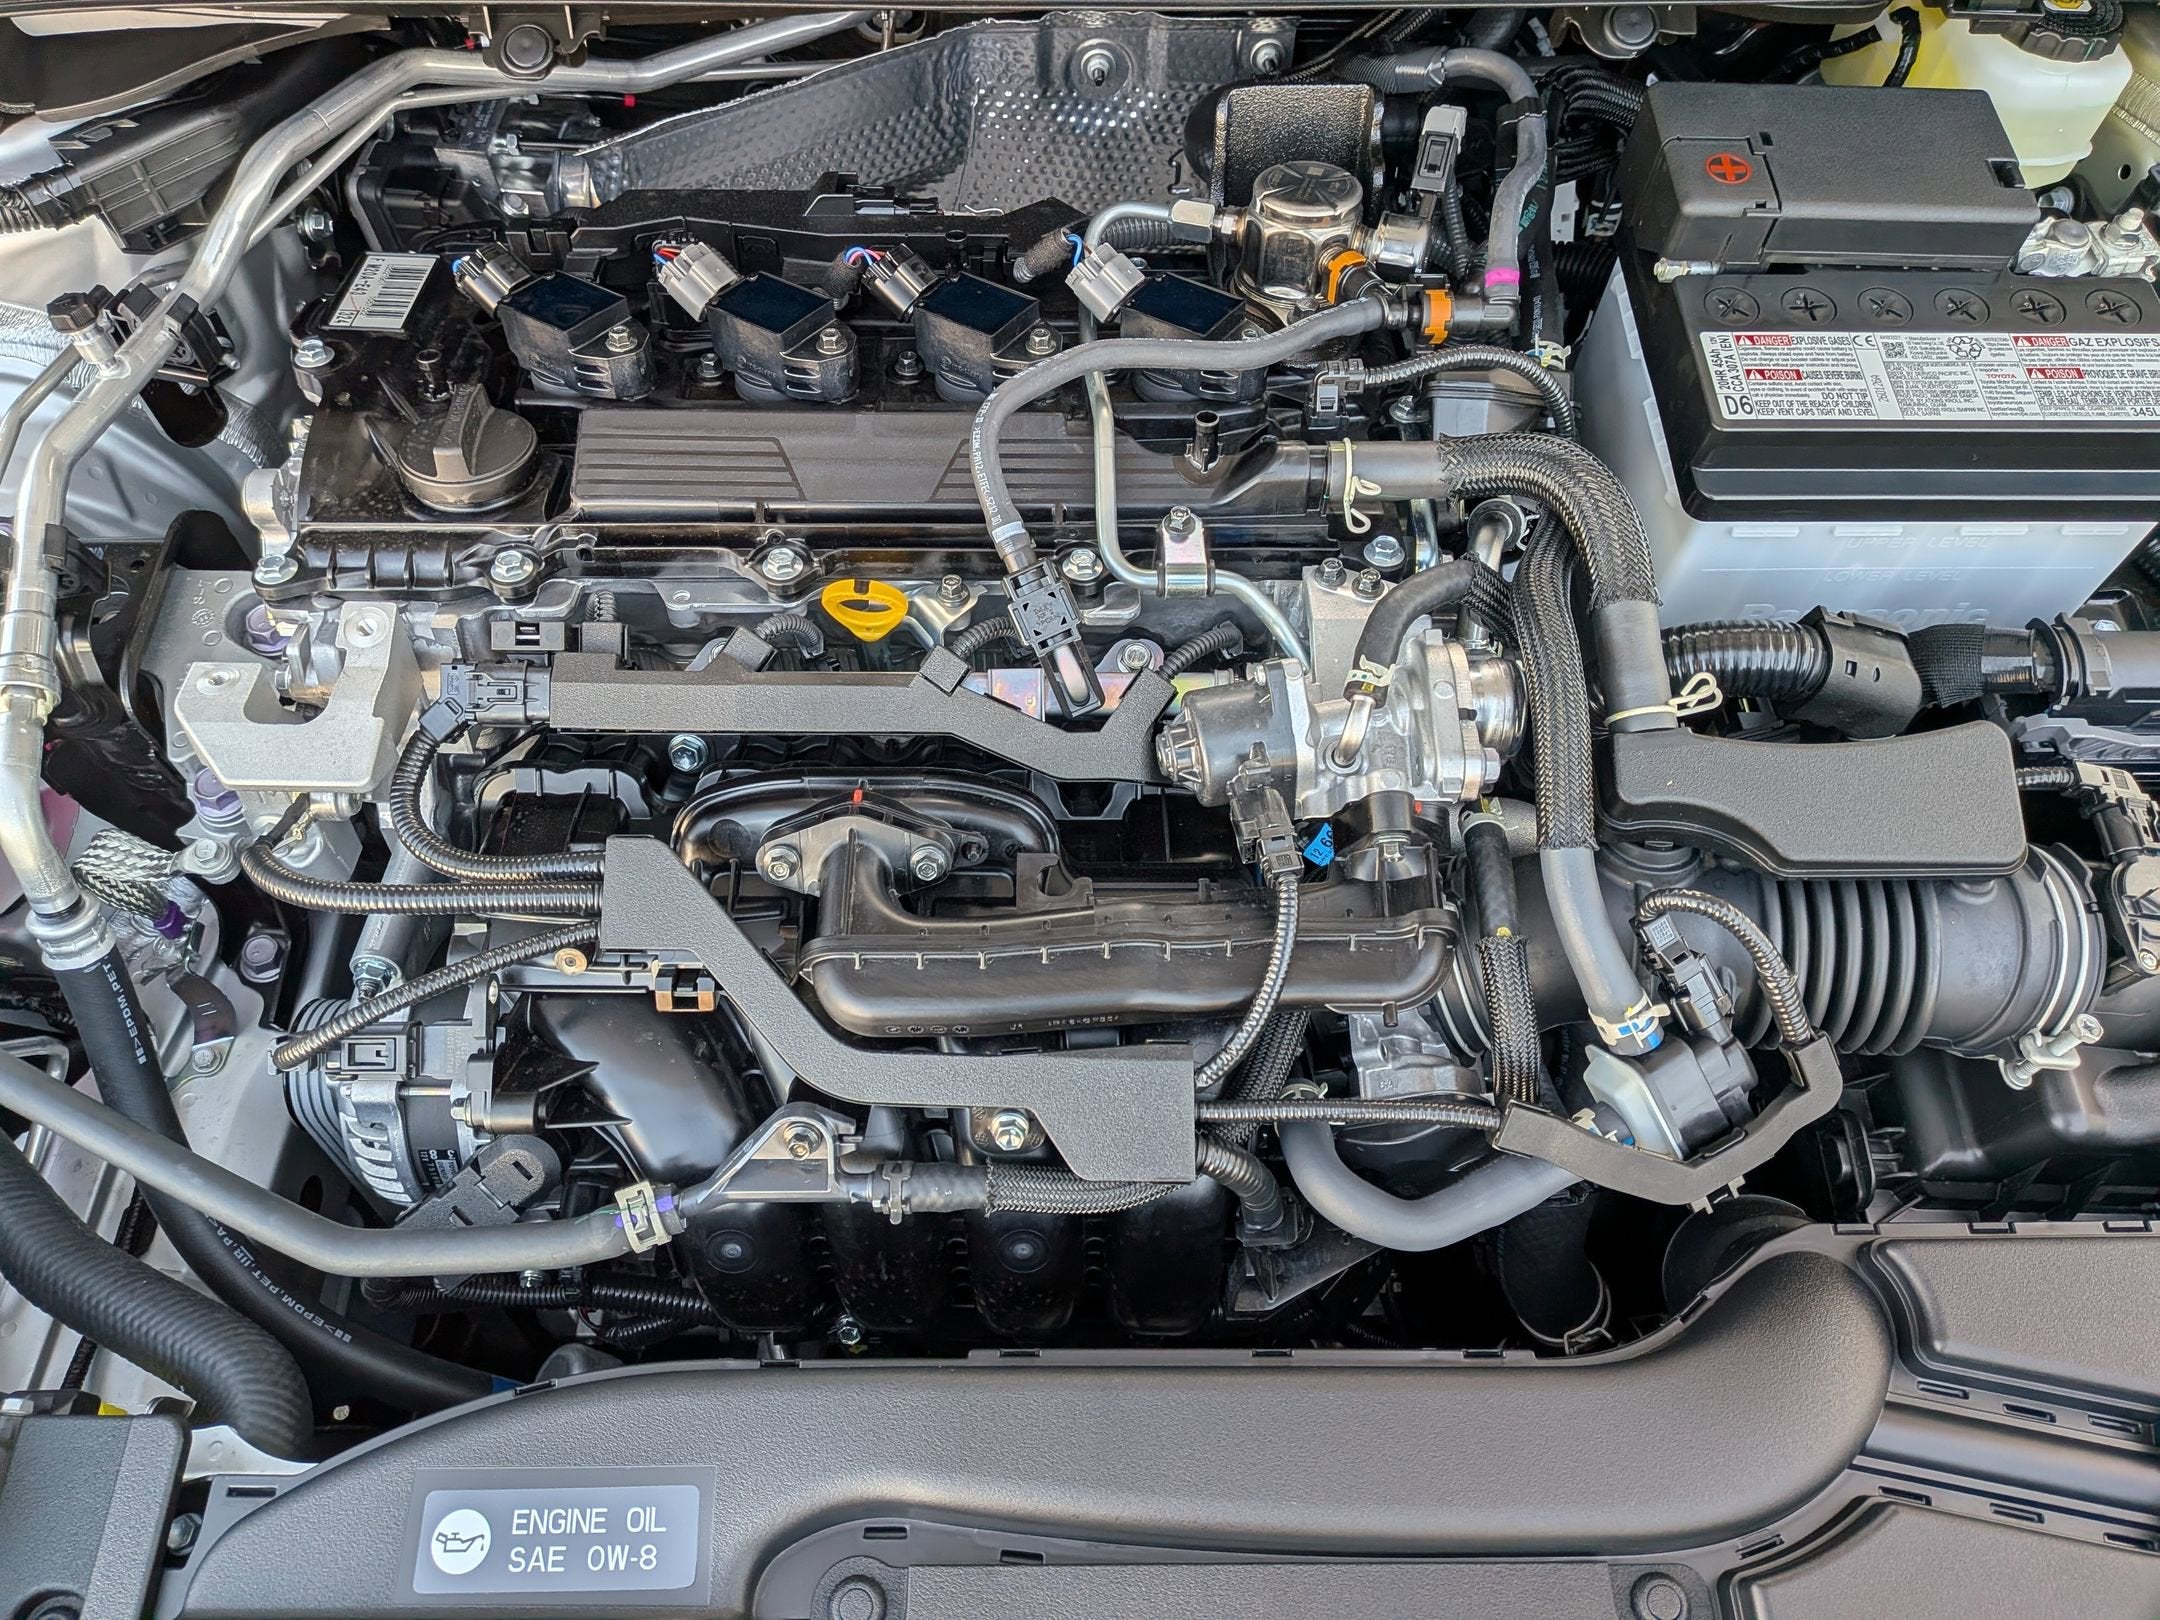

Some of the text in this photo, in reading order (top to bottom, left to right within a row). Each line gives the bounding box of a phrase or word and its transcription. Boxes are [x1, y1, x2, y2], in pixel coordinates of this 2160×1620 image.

[1753, 336, 1790, 346] DANGER
[1791, 337, 1852, 346] EXPLOSIVE GASES
[2031, 337, 2068, 347] DANGER
[2069, 337, 2160, 347] GAZ EXPLOSIFS
[1709, 349, 1724, 368] 45Ah
[1717, 335, 1745, 392] CCA 307A (EN)
[1764, 370, 1798, 380] POISON
[1802, 370, 1864, 380] CAUSES SEVERE BURNS
[2045, 369, 2079, 379] POISON
[2083, 370, 2149, 379] PROVOQUE DE GRAVE
[1714, 371, 1730, 390] 20HR
[1822, 392, 1868, 400] DO NOT TIP
[2035, 390, 2052, 398] TENIR
[2054, 390, 2068, 398] LES
[2068, 390, 2103, 398] CAPUCHONS
[2104, 390, 2113, 398] DE
[2114, 390, 2152, 398] VENTILATION
[1724, 395, 1754, 415] D6
[1754, 400, 1872, 408] KEEP OUT OF THE REACH OF CHILDREN
[1757, 408, 1775, 416] KEEP
[1776, 408, 1795, 416] VENT
[1795, 408, 1815, 416] CAPS
[1816, 408, 1836, 416] TIGHT
[1837, 408, 1854, 416] AND
[1848, 536, 1991, 549] UPPER LEVEL
[1824, 570, 1961, 582] LOWER LEVEL
[1311, 848, 1323, 858] 12
[511, 1506, 667, 1535] ENGINE OIL
[508, 1544, 657, 1573] SAE 0W-8
